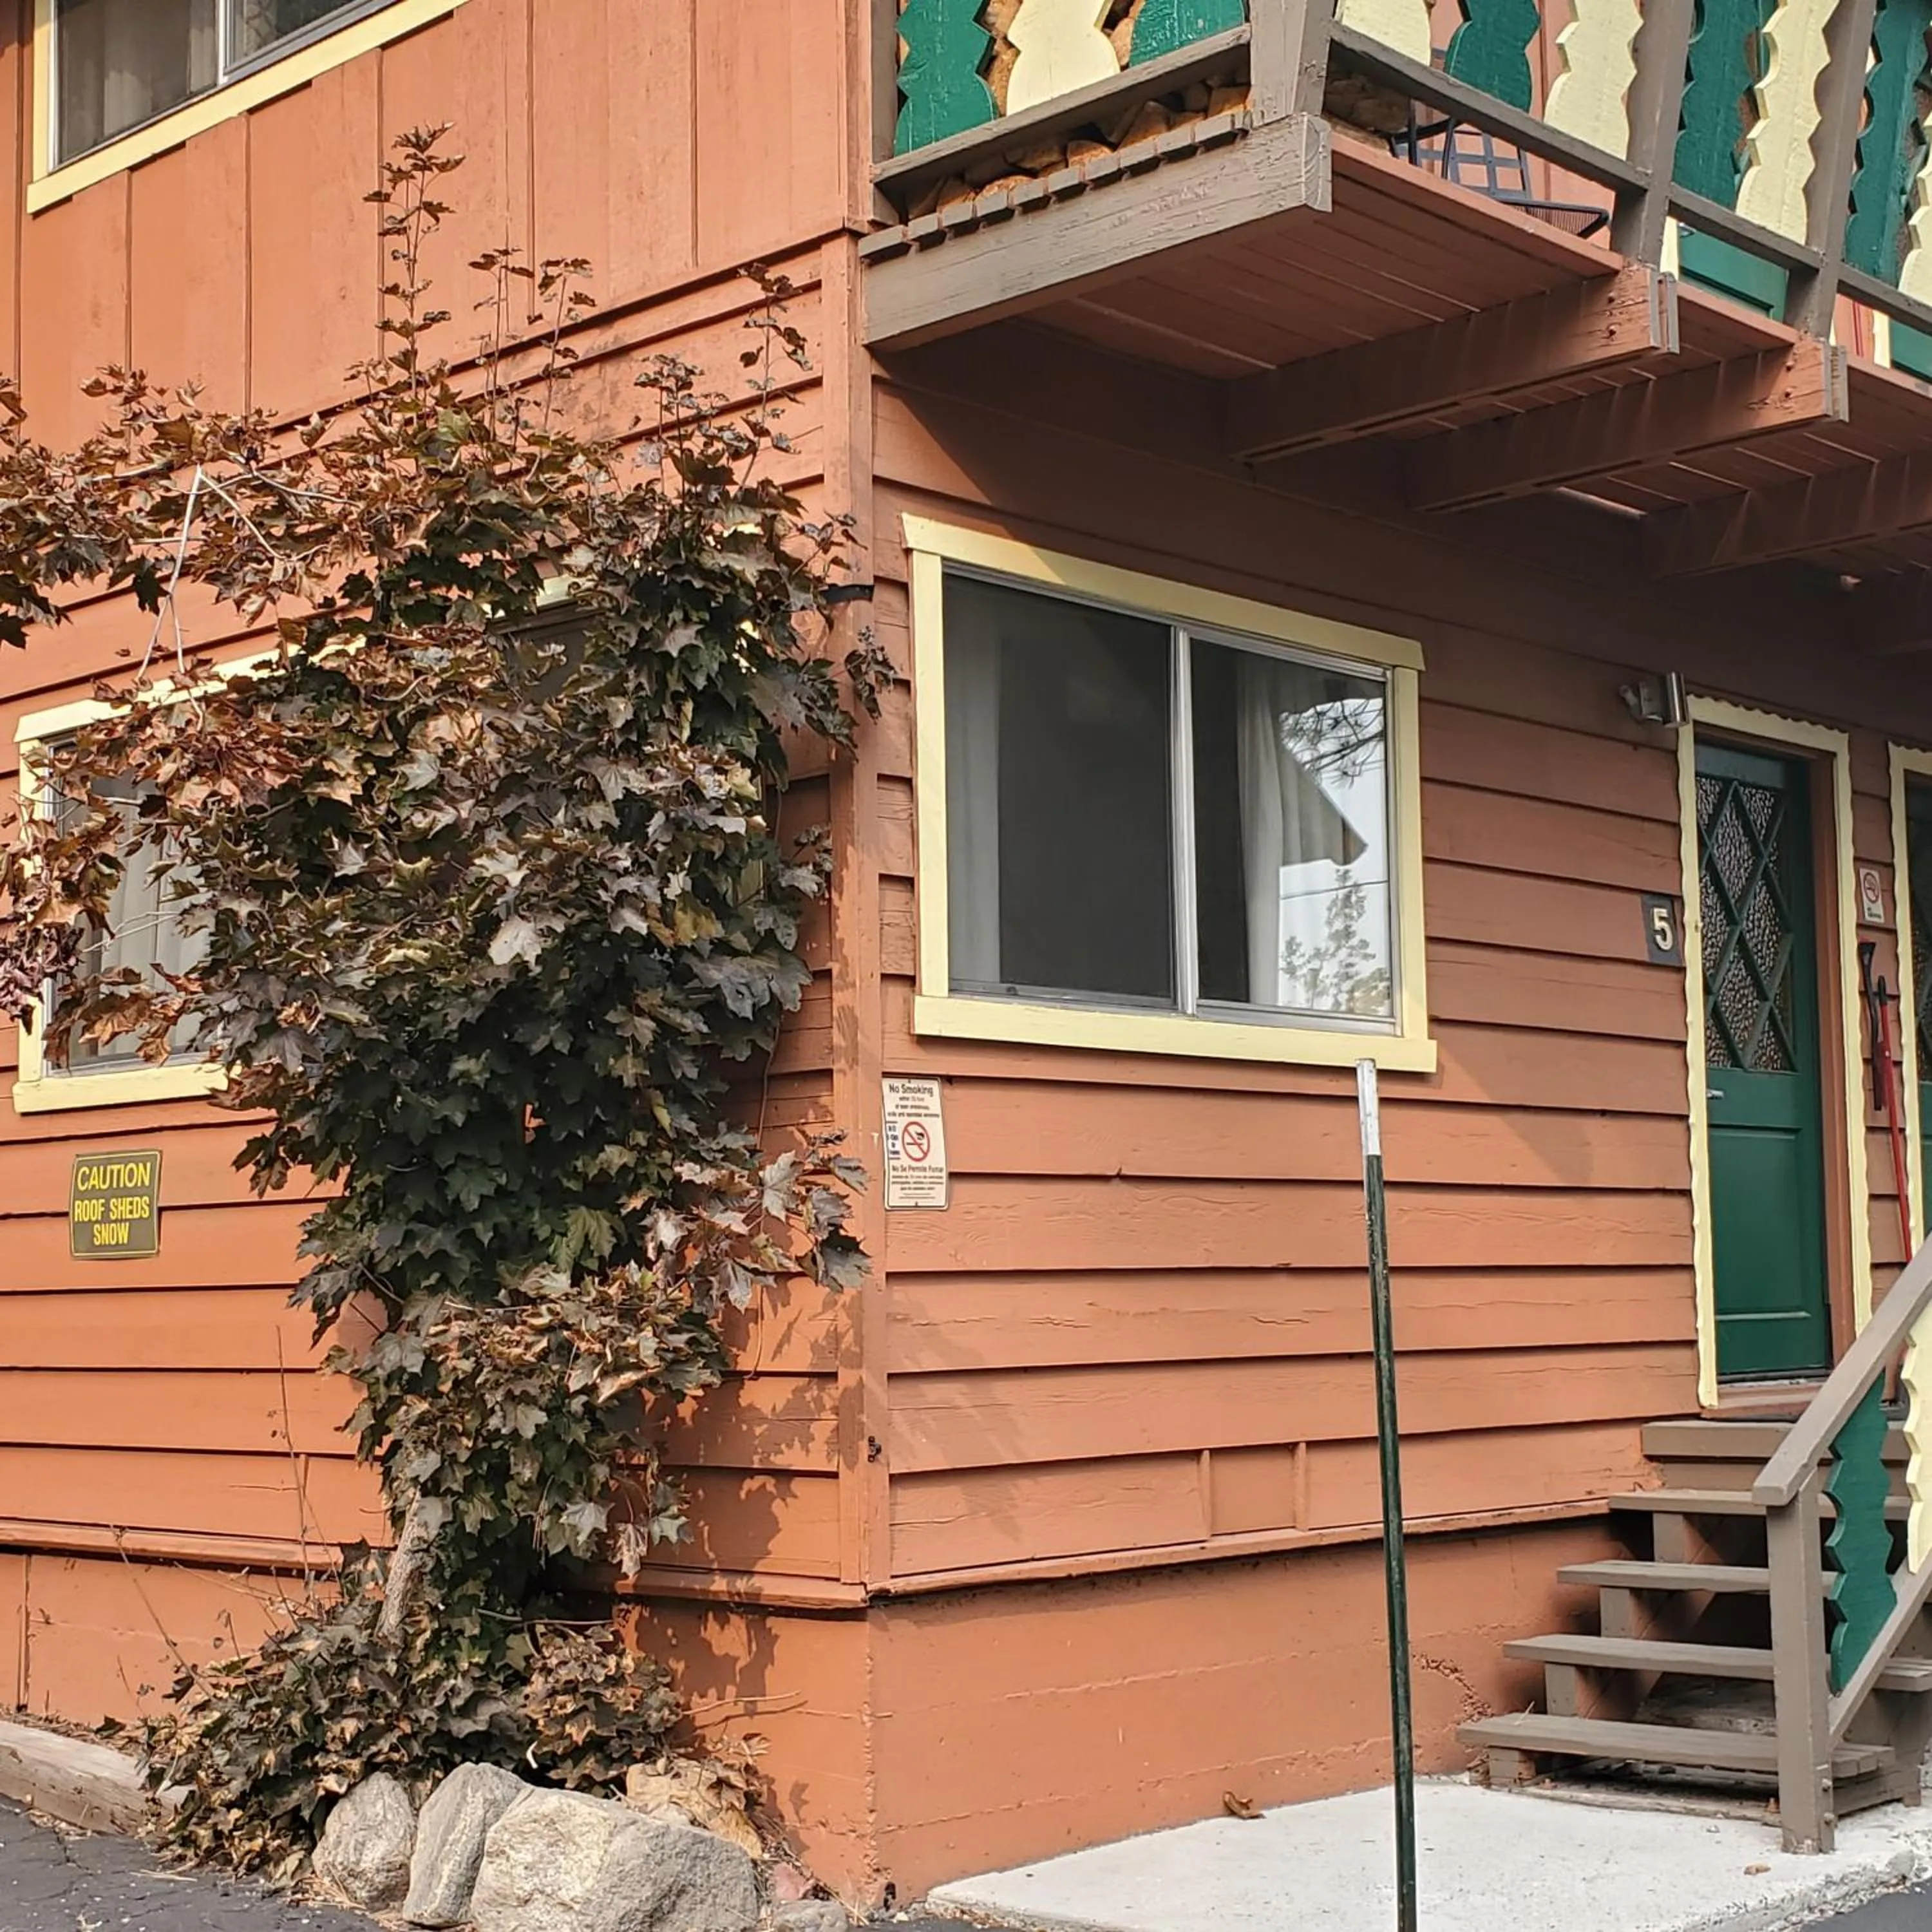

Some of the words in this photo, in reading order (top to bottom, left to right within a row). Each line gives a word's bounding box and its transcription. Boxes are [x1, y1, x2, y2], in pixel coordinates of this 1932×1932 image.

[1653, 907, 1673, 951] 5
[889, 1084, 900, 1094] No
[901, 1084, 933, 1097] Smoking
[77, 1162, 151, 1191] CAUTION
[74, 1198, 106, 1222] ROOF
[109, 1196, 150, 1220] SHEDS
[93, 1222, 129, 1246] SNOW
